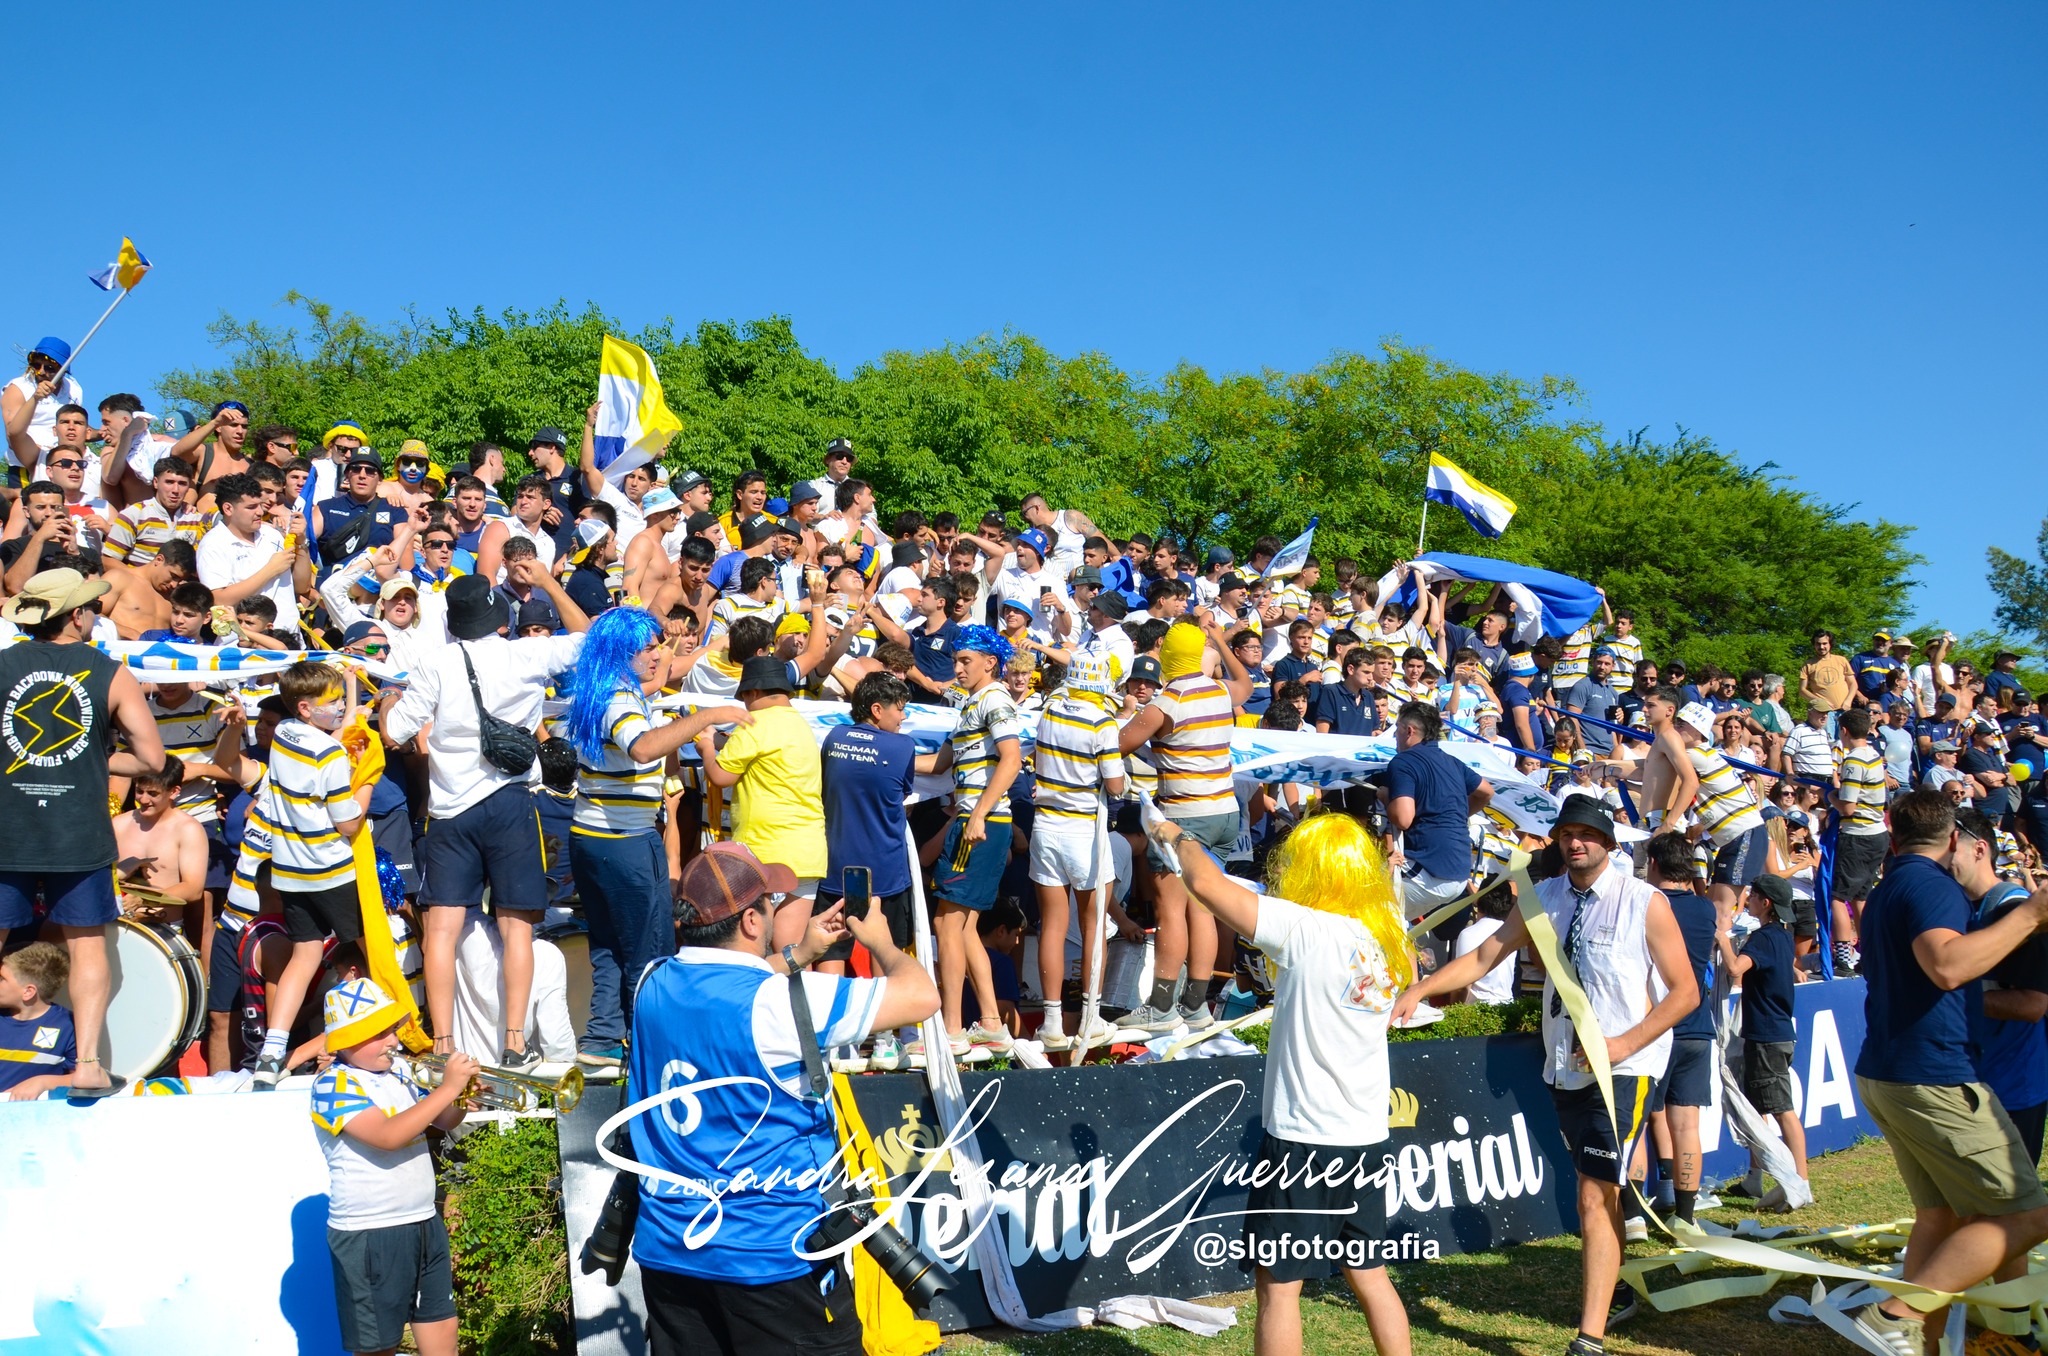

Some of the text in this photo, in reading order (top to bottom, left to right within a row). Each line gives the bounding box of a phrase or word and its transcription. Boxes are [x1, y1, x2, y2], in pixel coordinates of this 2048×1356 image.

[9, 670, 64, 702] BACKDOWN
[2, 699, 18, 737] NEVER
[846, 731, 875, 741] PROCER
[833, 742, 880, 756] TUCUMAN
[26, 752, 64, 768] FUARK
[659, 1059, 703, 1137] 6
[1583, 1146, 1618, 1160] PROCER
